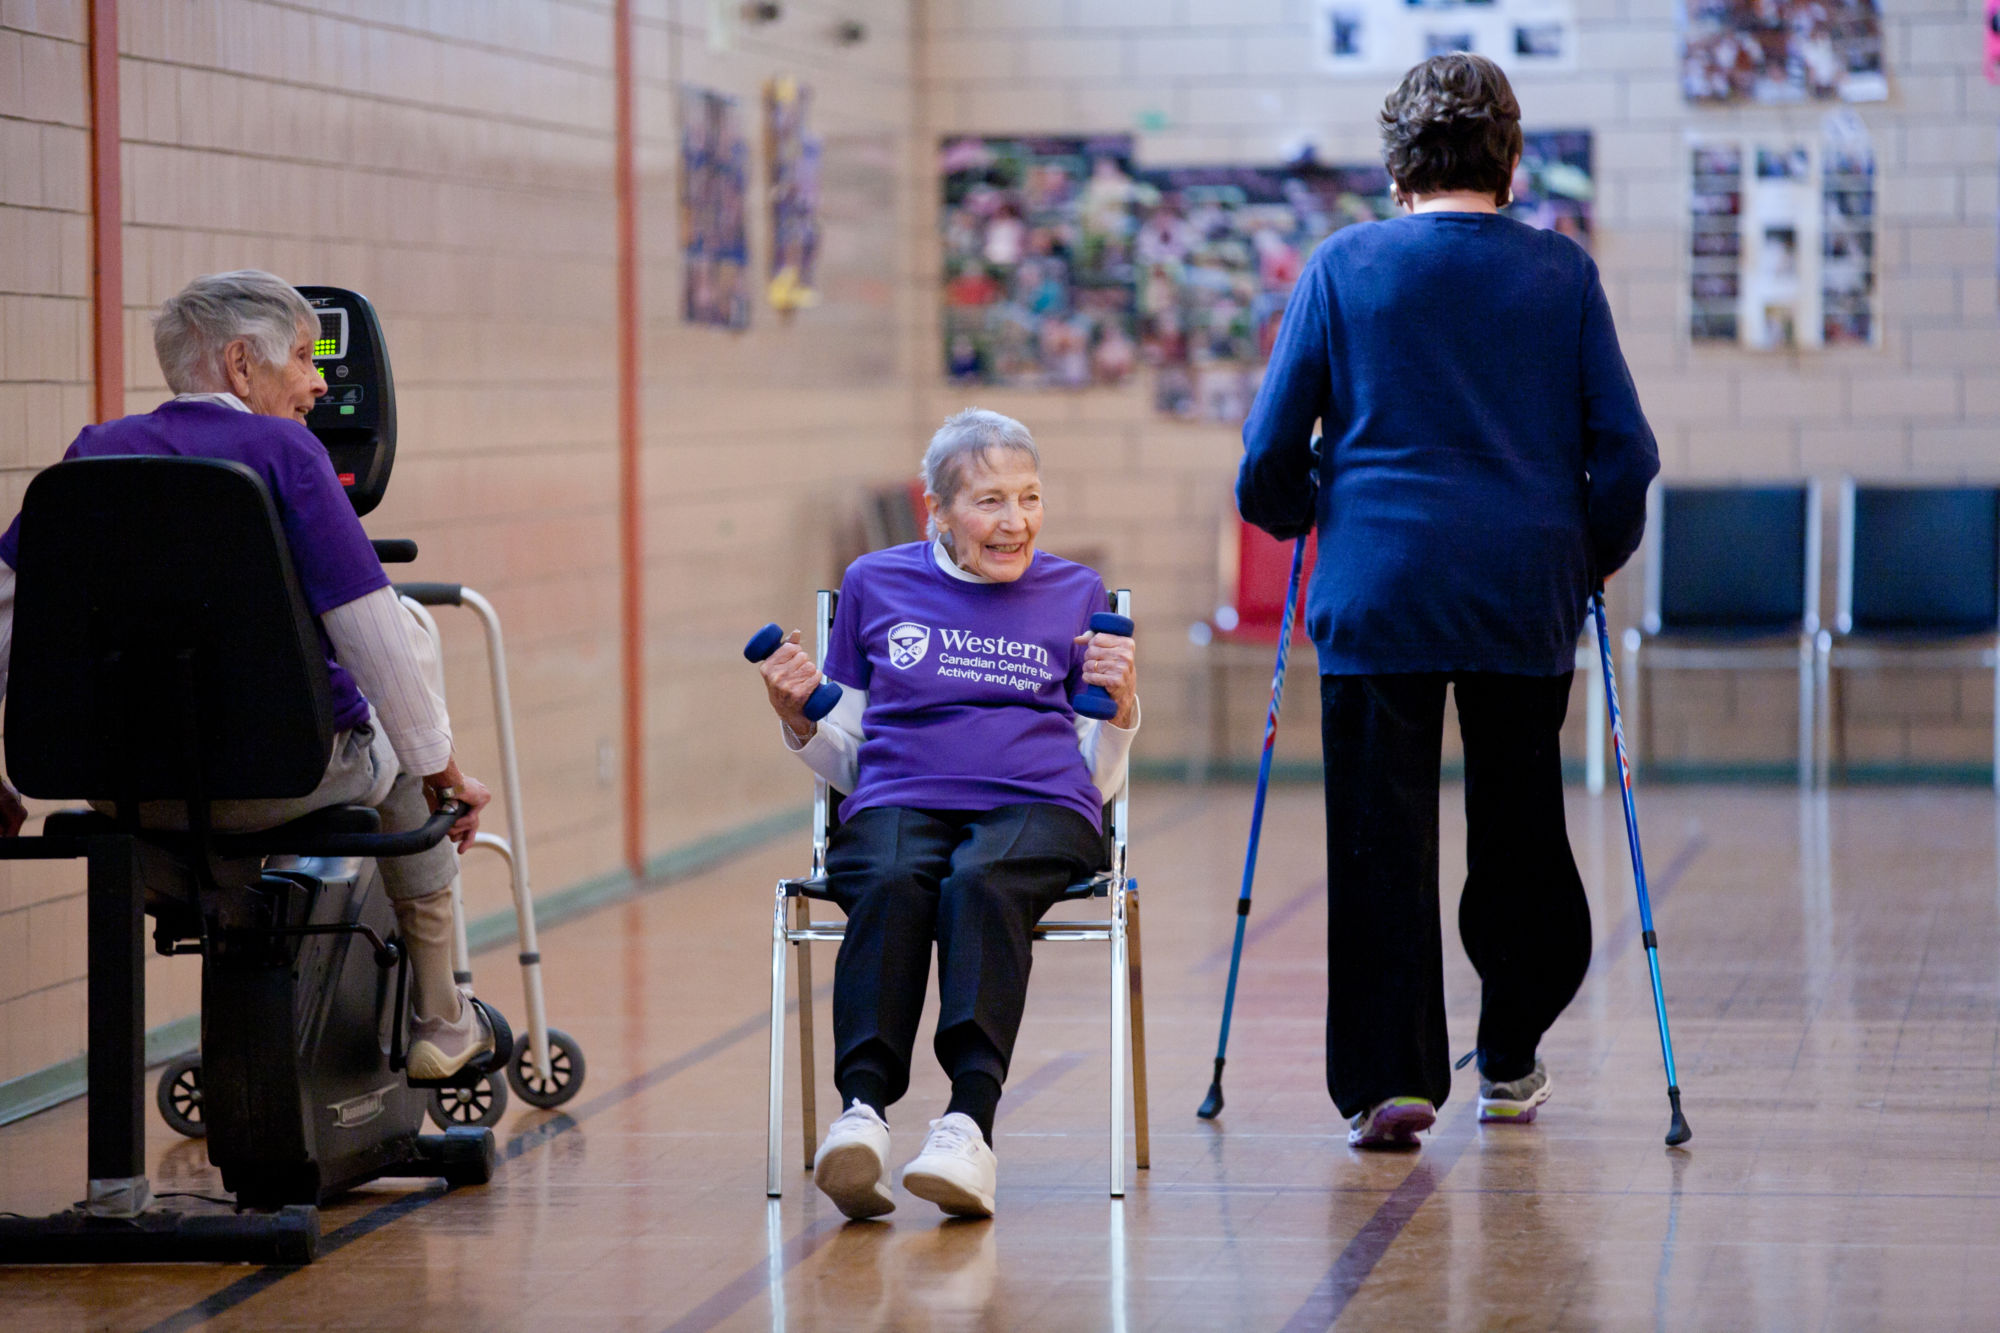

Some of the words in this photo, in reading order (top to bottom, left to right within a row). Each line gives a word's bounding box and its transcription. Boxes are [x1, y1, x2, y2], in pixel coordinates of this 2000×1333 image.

[938, 628, 1049, 667] Western
[937, 665, 983, 683] Activity
[984, 672, 1008, 685] and
[1008, 675, 1043, 694] Aging
[938, 652, 996, 670] Canadian
[998, 659, 1038, 676] Centre
[1039, 667, 1053, 681] for
